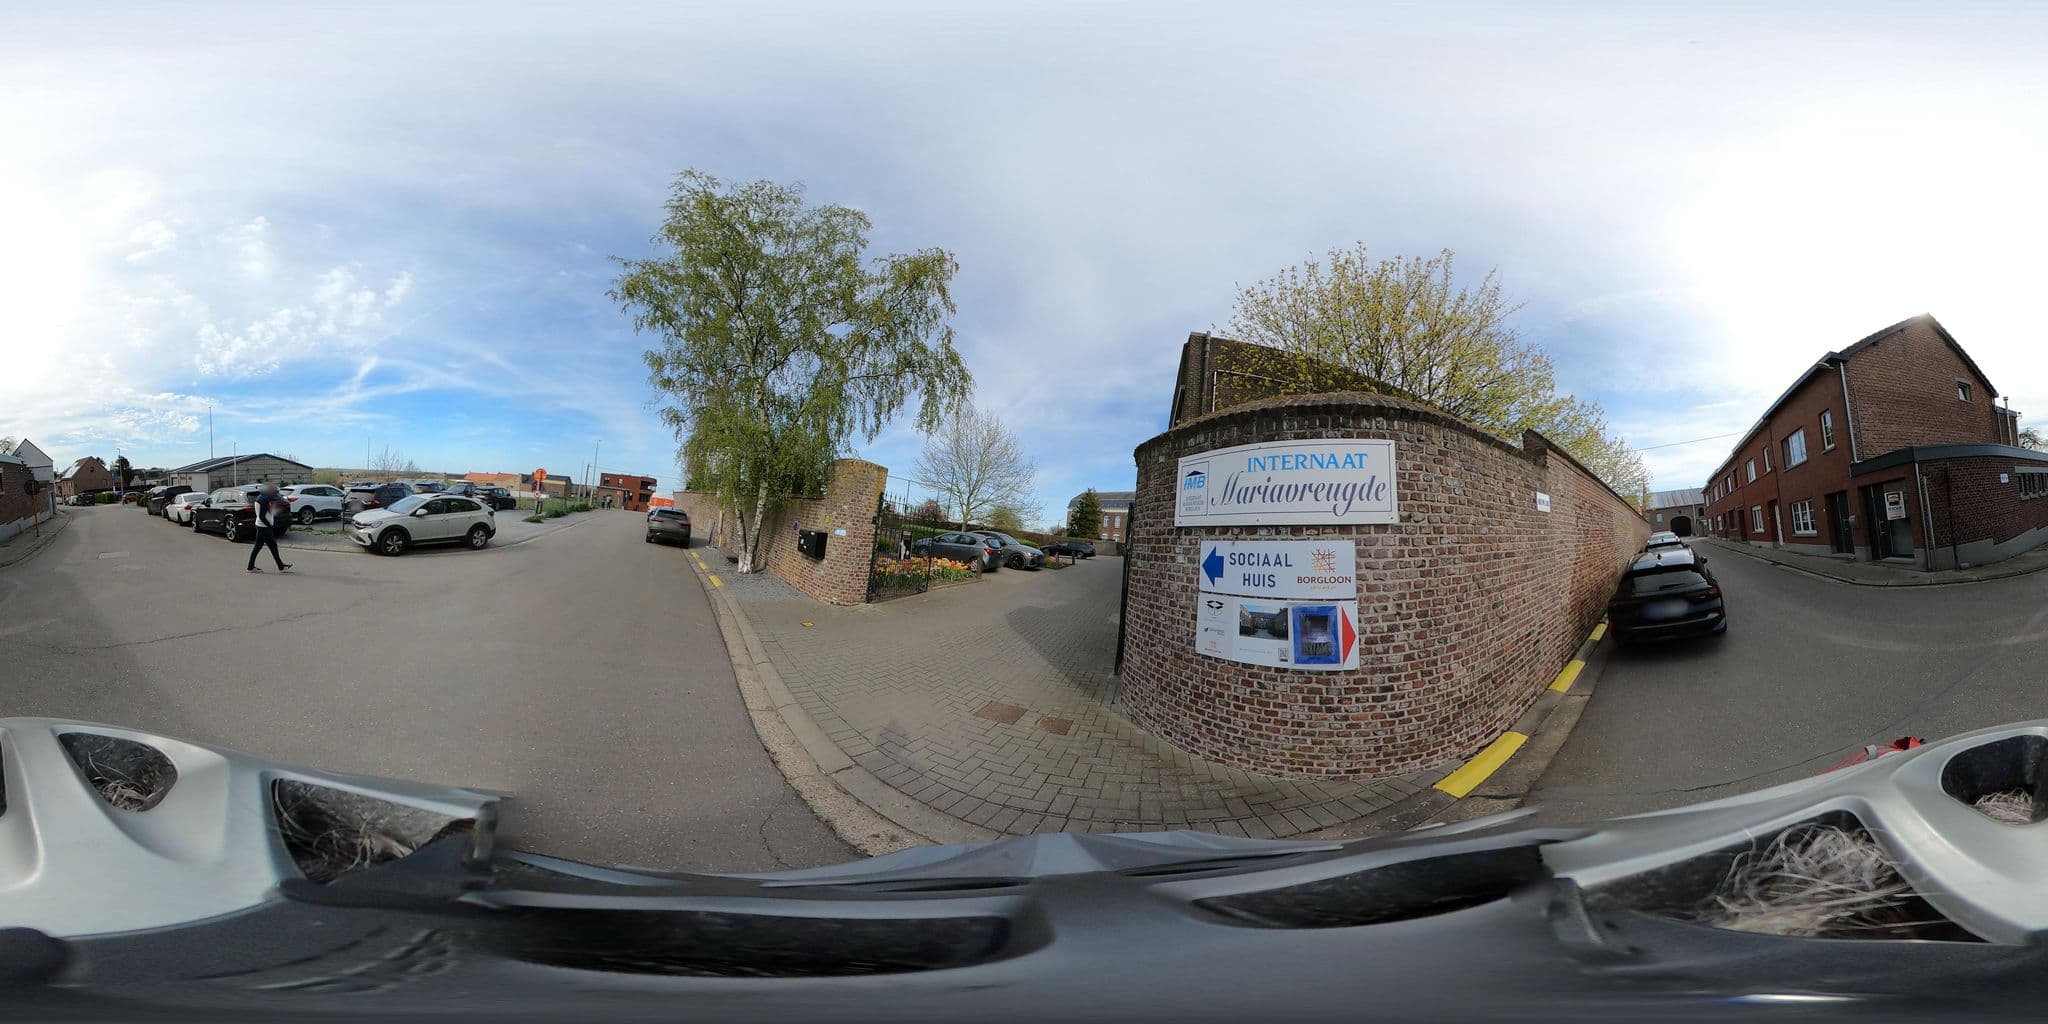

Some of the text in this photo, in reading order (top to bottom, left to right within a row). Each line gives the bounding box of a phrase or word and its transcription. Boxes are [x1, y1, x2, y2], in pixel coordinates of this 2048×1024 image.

[1247, 453, 1368, 472] INTERNAAT
[1184, 475, 1206, 490] IMB
[1211, 471, 1386, 517] Mariavreugde
[1229, 552, 1292, 567] SOCIAAL
[1242, 573, 1276, 588] HUIS
[1297, 576, 1351, 584] BORGLOON
